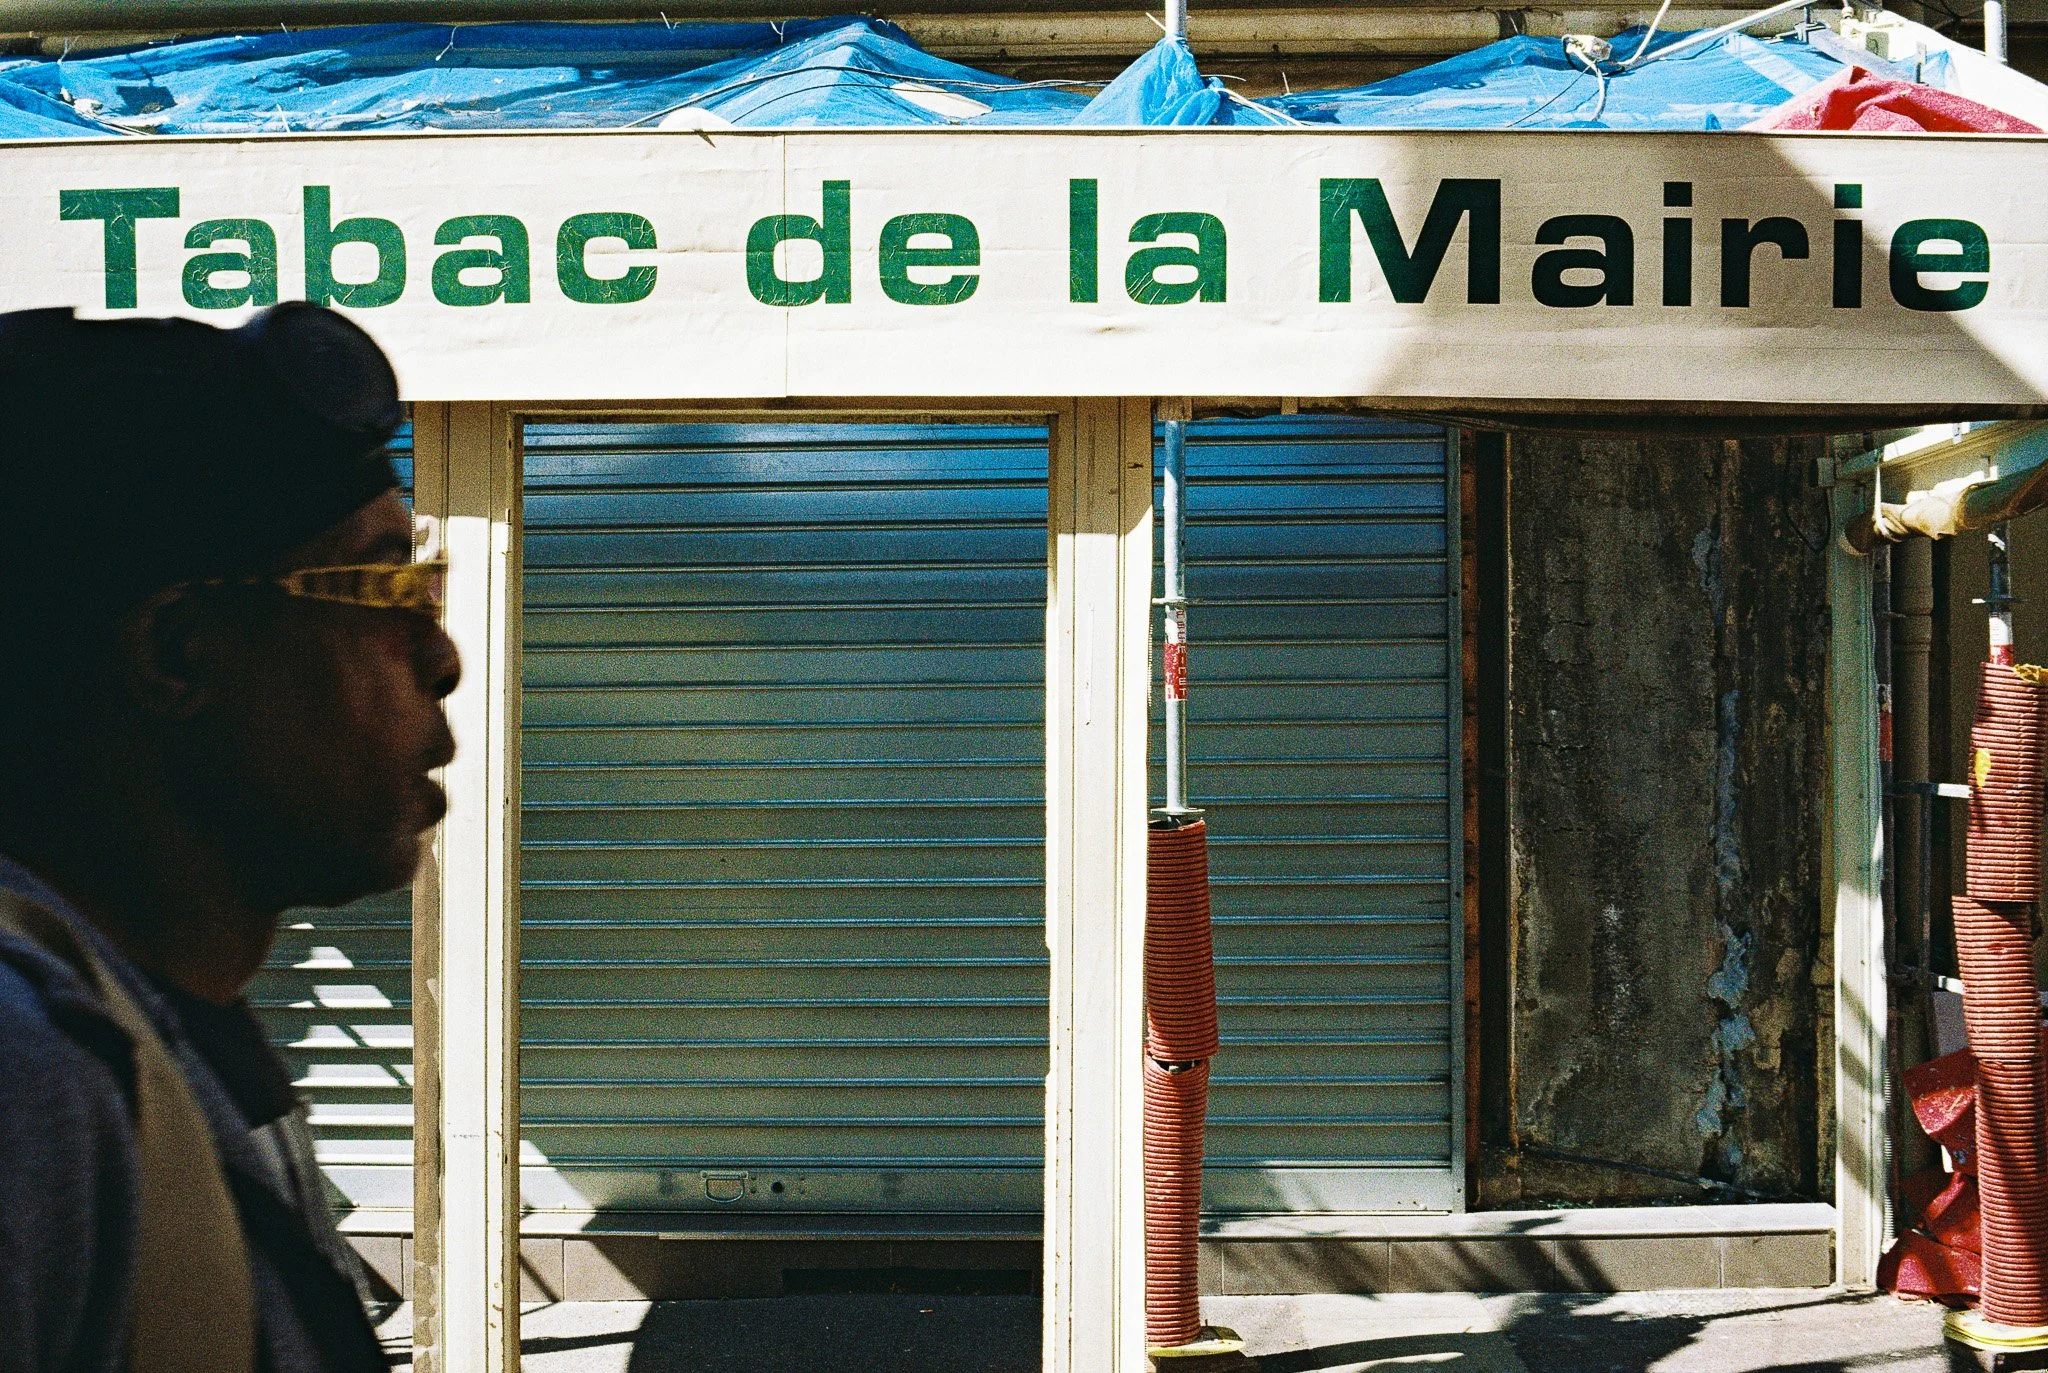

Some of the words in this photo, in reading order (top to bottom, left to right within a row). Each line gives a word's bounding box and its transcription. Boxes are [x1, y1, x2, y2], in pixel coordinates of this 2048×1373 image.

[60, 185, 658, 309] Tabac
[746, 180, 981, 306] de
[1070, 178, 1227, 305] la
[1319, 178, 1990, 312] Mairie
